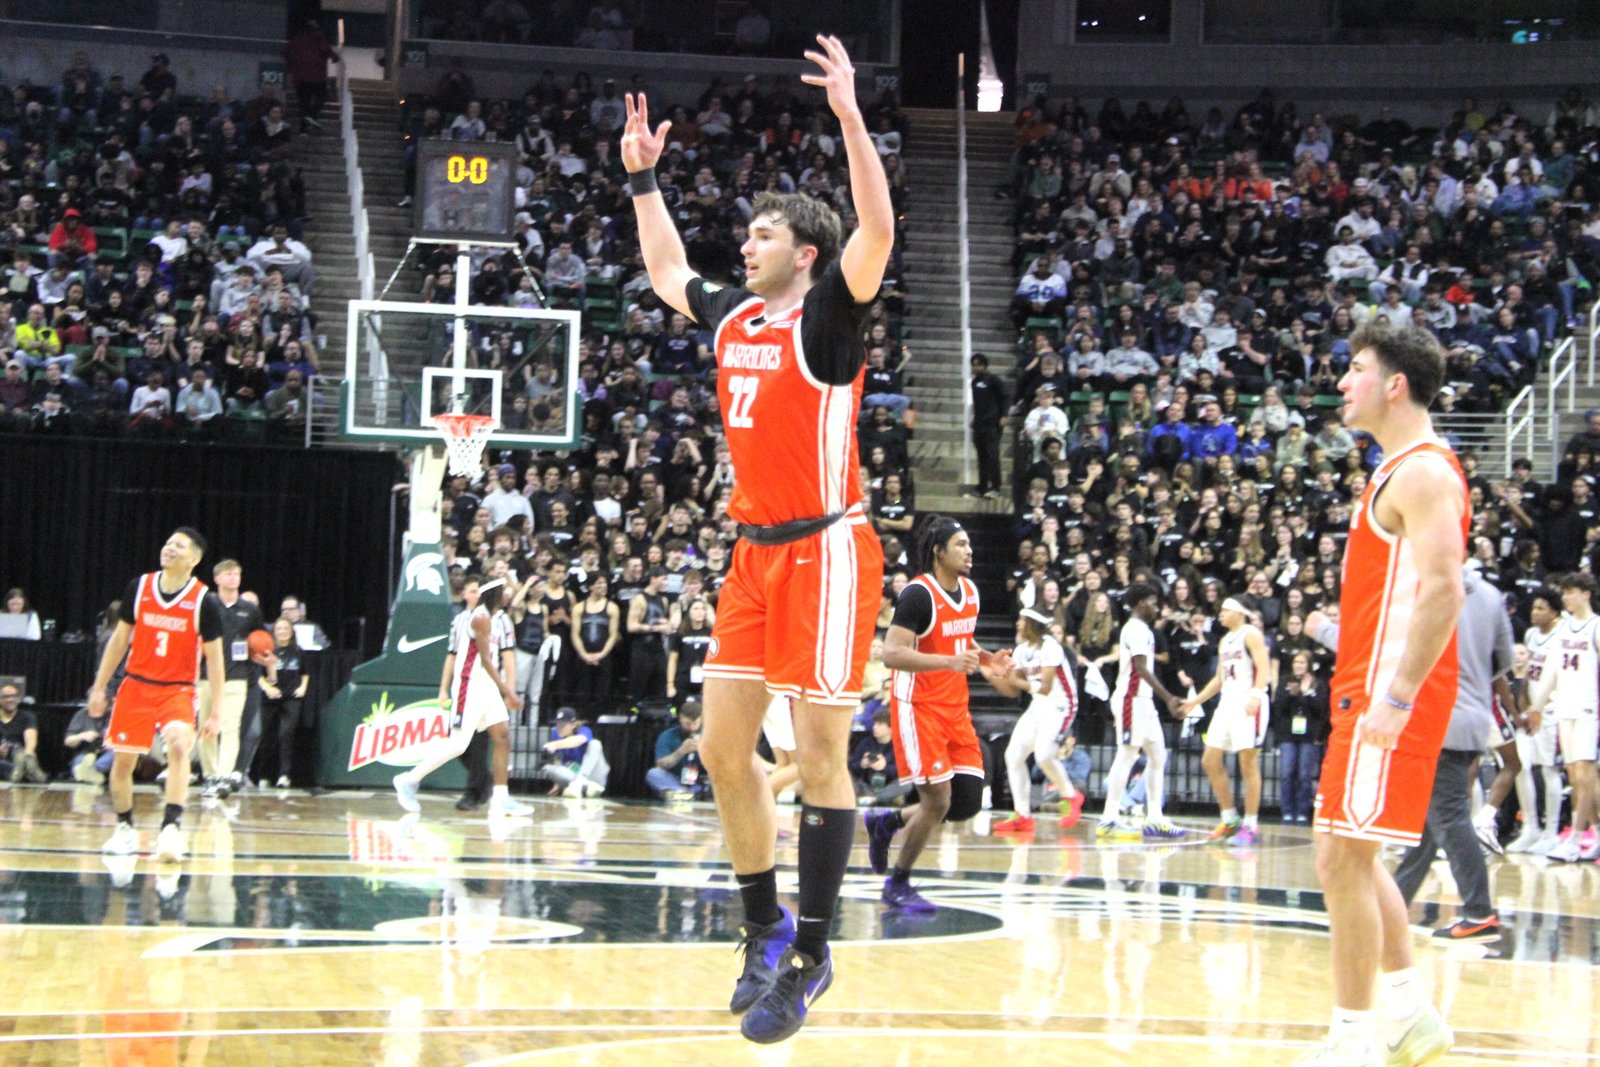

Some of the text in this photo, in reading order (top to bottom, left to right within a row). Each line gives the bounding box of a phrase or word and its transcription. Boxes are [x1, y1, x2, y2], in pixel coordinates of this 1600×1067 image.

[262, 70, 283, 83] 101
[722, 343, 782, 370] WARRIORS
[728, 375, 759, 428] 22
[142, 612, 188, 632] WARRIORS
[154, 630, 170, 657] 3
